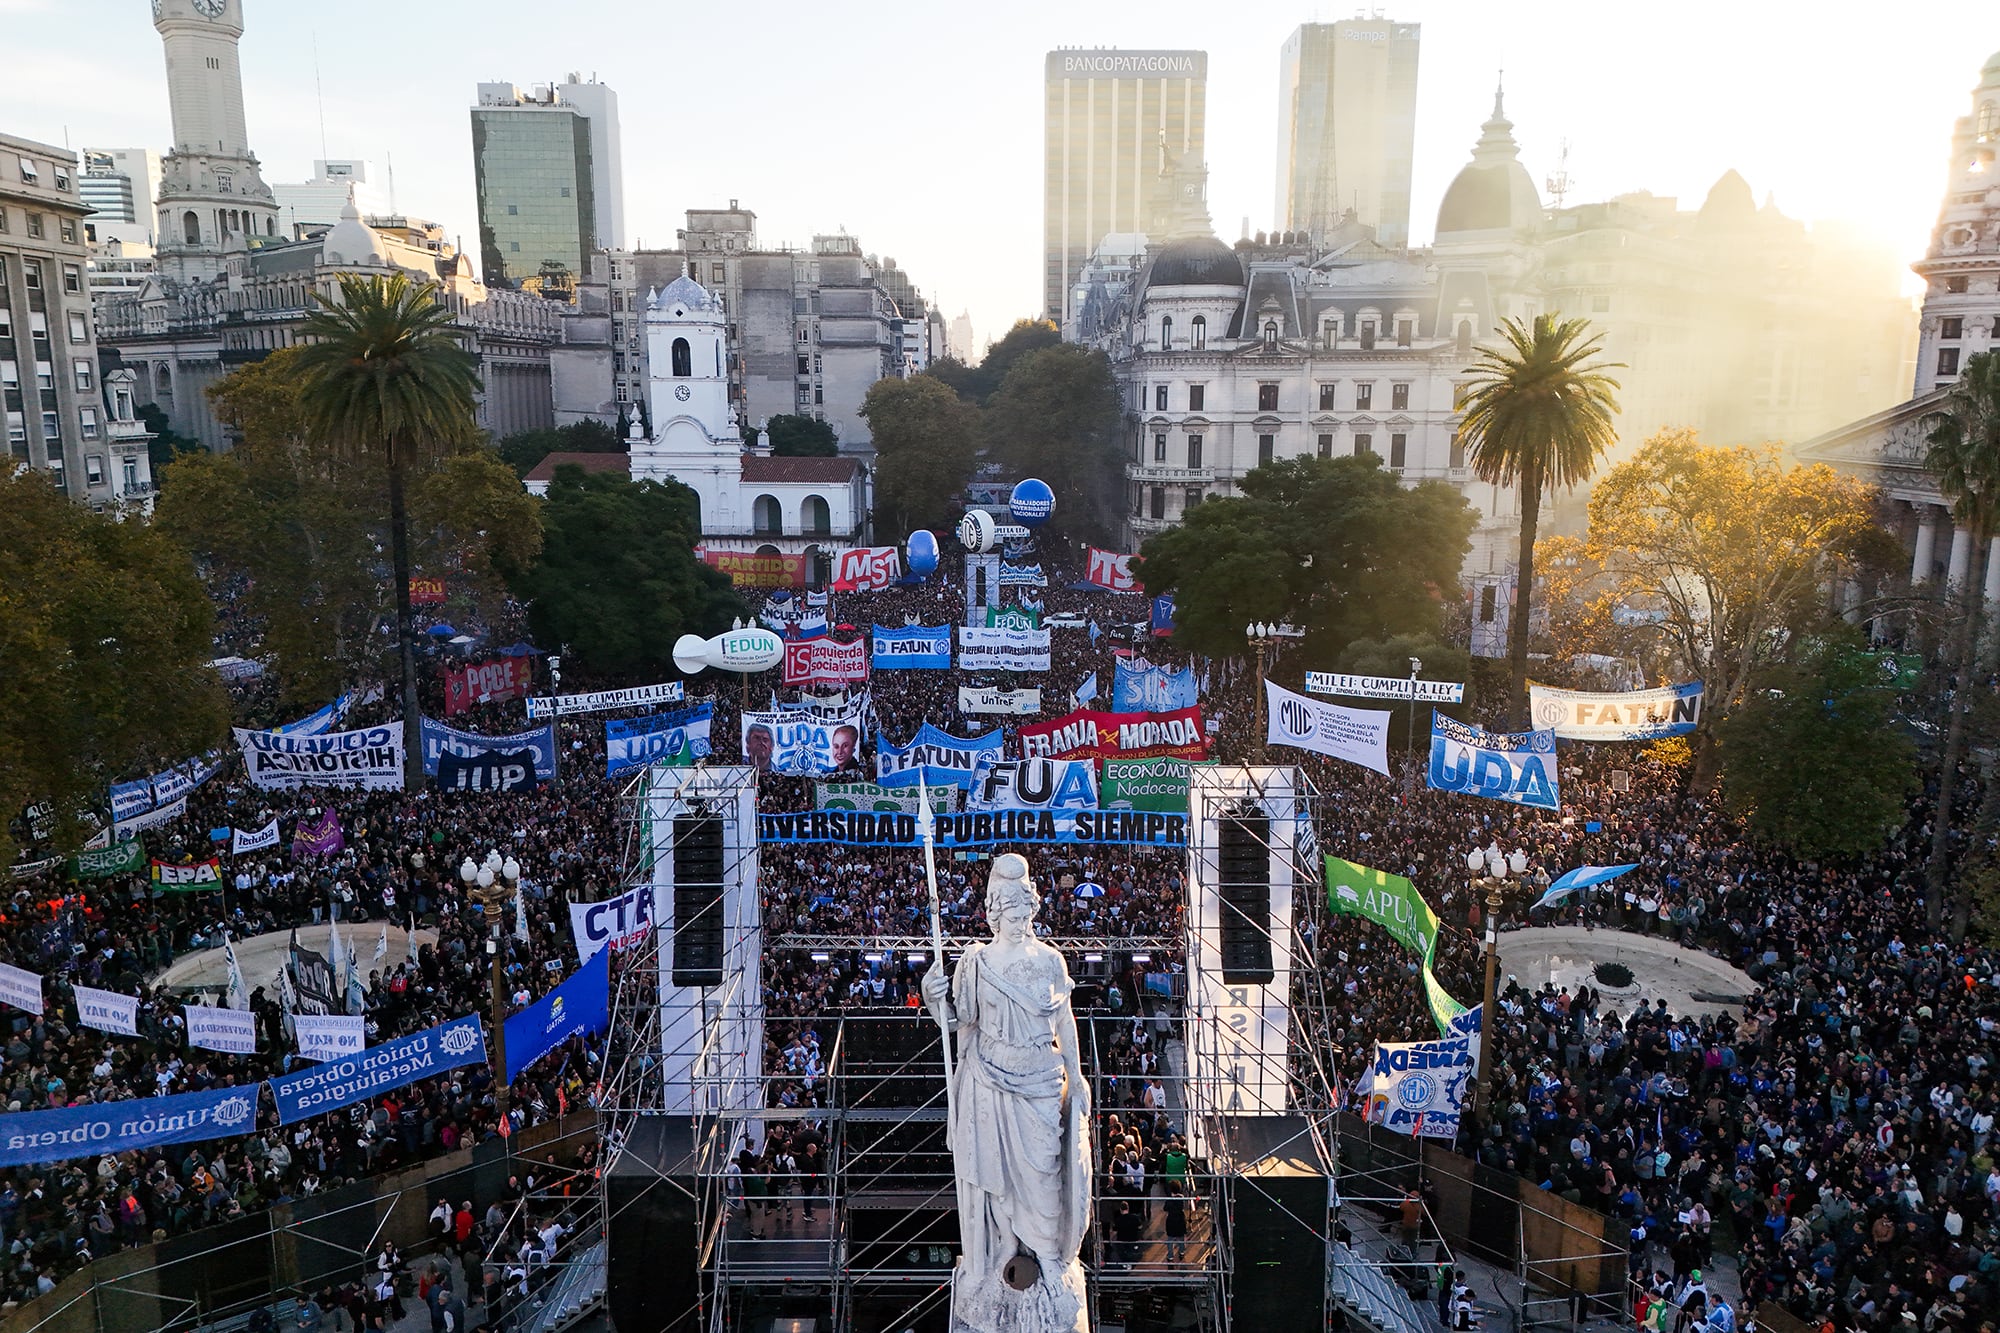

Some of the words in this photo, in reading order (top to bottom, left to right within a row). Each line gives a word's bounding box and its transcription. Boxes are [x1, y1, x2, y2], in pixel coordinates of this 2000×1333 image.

[1343, 29, 1386, 43] Pampa
[1064, 56, 1193, 72] BANCOPATAGONIA
[718, 556, 798, 573] PARTIDO
[1089, 549, 1134, 589] PTS
[732, 573, 794, 586] BRERO
[812, 644, 864, 661] izquierda
[890, 640, 932, 654] FATUN
[812, 654, 864, 672] socialista
[587, 691, 634, 704] CUMPLI
[637, 688, 652, 699] LA
[655, 684, 676, 696] LEY
[1126, 672, 1172, 707] SUR
[1310, 684, 1332, 692] FRENTE
[1335, 687, 1361, 696] SINDICAL
[1311, 673, 1357, 688] MILEI:
[1361, 678, 1410, 692] CUMPLI
[1414, 681, 1428, 694] LA
[1432, 684, 1454, 696] LEY
[536, 708, 555, 717] FRENT
[562, 704, 589, 713] SINDICAL
[1280, 700, 1313, 736] MUC
[1576, 696, 1698, 726] FATUN
[1320, 716, 1356, 728] PATRIOTAS
[1338, 726, 1358, 734] NADA
[1436, 714, 1472, 736] SERGIO
[626, 727, 687, 764] UDA
[776, 724, 830, 750] UDA
[1022, 718, 1100, 759] FRANJA
[1119, 717, 1200, 750] MORADA
[1444, 730, 1518, 751] CONDUCCION
[900, 744, 971, 770] FATUN
[1108, 757, 1188, 779] ECONÓMI
[1430, 737, 1558, 808] UDA
[159, 783, 172, 795] NO
[980, 758, 1098, 809] FUA
[238, 828, 274, 847] feduba
[760, 810, 916, 844] IVERSIDAD
[160, 864, 218, 884] EPA
[546, 1012, 567, 1034] UATRE
